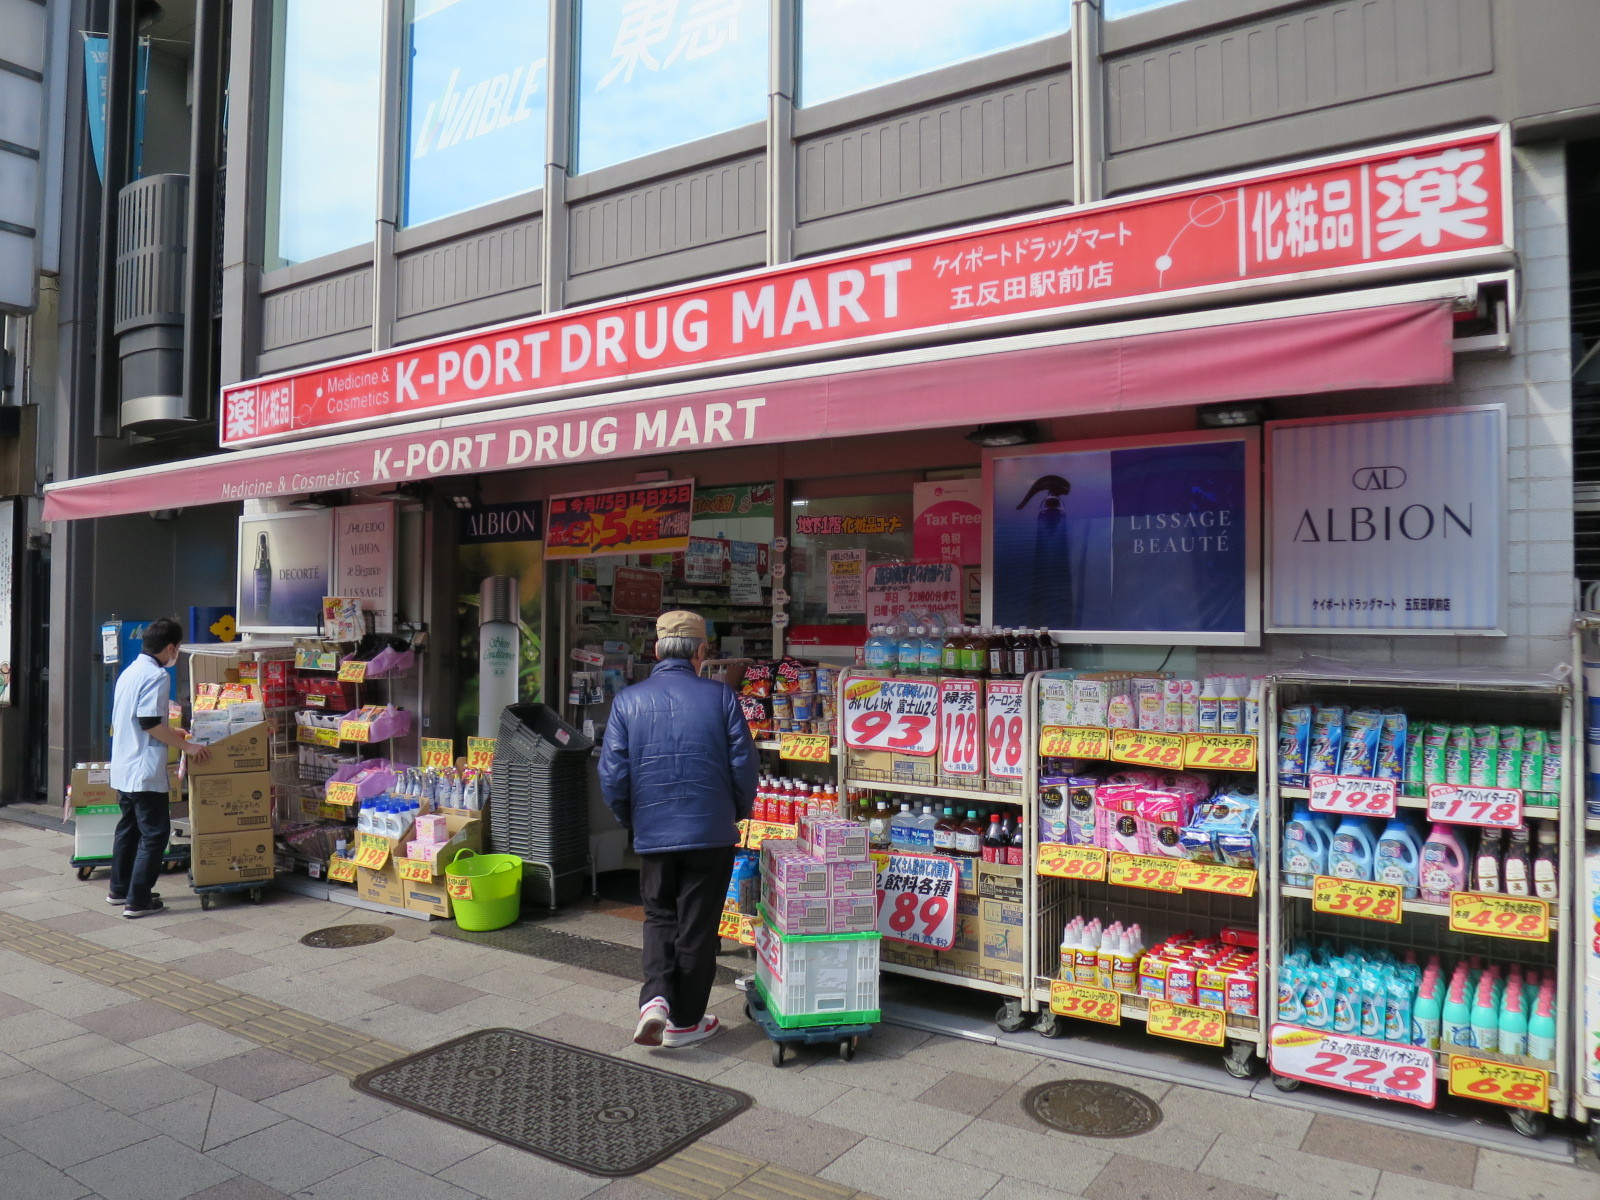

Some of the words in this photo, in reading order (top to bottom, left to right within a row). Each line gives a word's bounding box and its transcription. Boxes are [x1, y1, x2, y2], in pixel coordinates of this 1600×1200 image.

[1376, 148, 1489, 254] 薬
[1252, 179, 1354, 263] 化粧品
[932, 222, 1133, 279] ケイポートドラッグマート
[950, 261, 1113, 311] 五反田駅前店
[396, 330, 550, 403] K-PORT
[561, 298, 708, 373] DRUG
[732, 258, 912, 344] MART
[327, 371, 379, 394] Medicine
[381, 369, 390, 383] &
[260, 386, 290, 428] 化粧品
[327, 389, 390, 414] Cosmetics
[227, 390, 255, 438] 薬
[220, 478, 273, 500] Medicine
[277, 475, 286, 493] &
[292, 468, 360, 491] Cosmetics
[372, 432, 497, 481] K-PORT
[506, 415, 618, 465] DRUG
[633, 397, 766, 450] MART
[345, 521, 385, 535] SHISEIDO
[467, 510, 536, 536] ALBION
[925, 513, 947, 526] Tax
[952, 511, 981, 524] Free
[1130, 510, 1231, 531] LISSAGE
[1292, 502, 1473, 543] ALBION
[350, 543, 380, 556] ALBION
[1133, 530, 1229, 554] BEAUTÉ
[279, 565, 320, 580] DECORTÉ
[344, 587, 384, 598] LISSAGE
[945, 683, 974, 691] お買得!
[991, 685, 1022, 694] お買得!
[848, 697, 893, 712] おいしい水
[943, 691, 975, 705] 緑茶
[988, 694, 1022, 707] ウーロン茶
[851, 711, 931, 748] 93
[943, 712, 977, 764] 128
[789, 744, 826, 759] 108
[988, 715, 1023, 767] 98
[1046, 739, 1072, 753] 838
[1076, 740, 1103, 755] 938
[425, 751, 451, 767] 198
[1124, 744, 1181, 763] 248
[1192, 746, 1252, 765] 128
[1325, 790, 1391, 810] 198
[1445, 800, 1517, 822] 178
[359, 847, 385, 865] 198
[1049, 857, 1102, 876] 980
[405, 867, 430, 880] 188
[1123, 866, 1176, 887] 398
[1187, 872, 1249, 890] 378
[884, 873, 953, 898] 飲料各種
[1340, 884, 1373, 896] ボールド
[1378, 888, 1397, 899] 本体
[1329, 894, 1396, 916] 398
[719, 921, 740, 935] 75
[1468, 910, 1542, 932] 498
[897, 931, 948, 947] +消費税
[1063, 997, 1116, 1018] 398
[1162, 1016, 1221, 1038] 348
[1320, 1038, 1430, 1068] アタック高浸透バイオジェル
[1305, 1052, 1427, 1091] 228
[1467, 1078, 1541, 1101] 68
